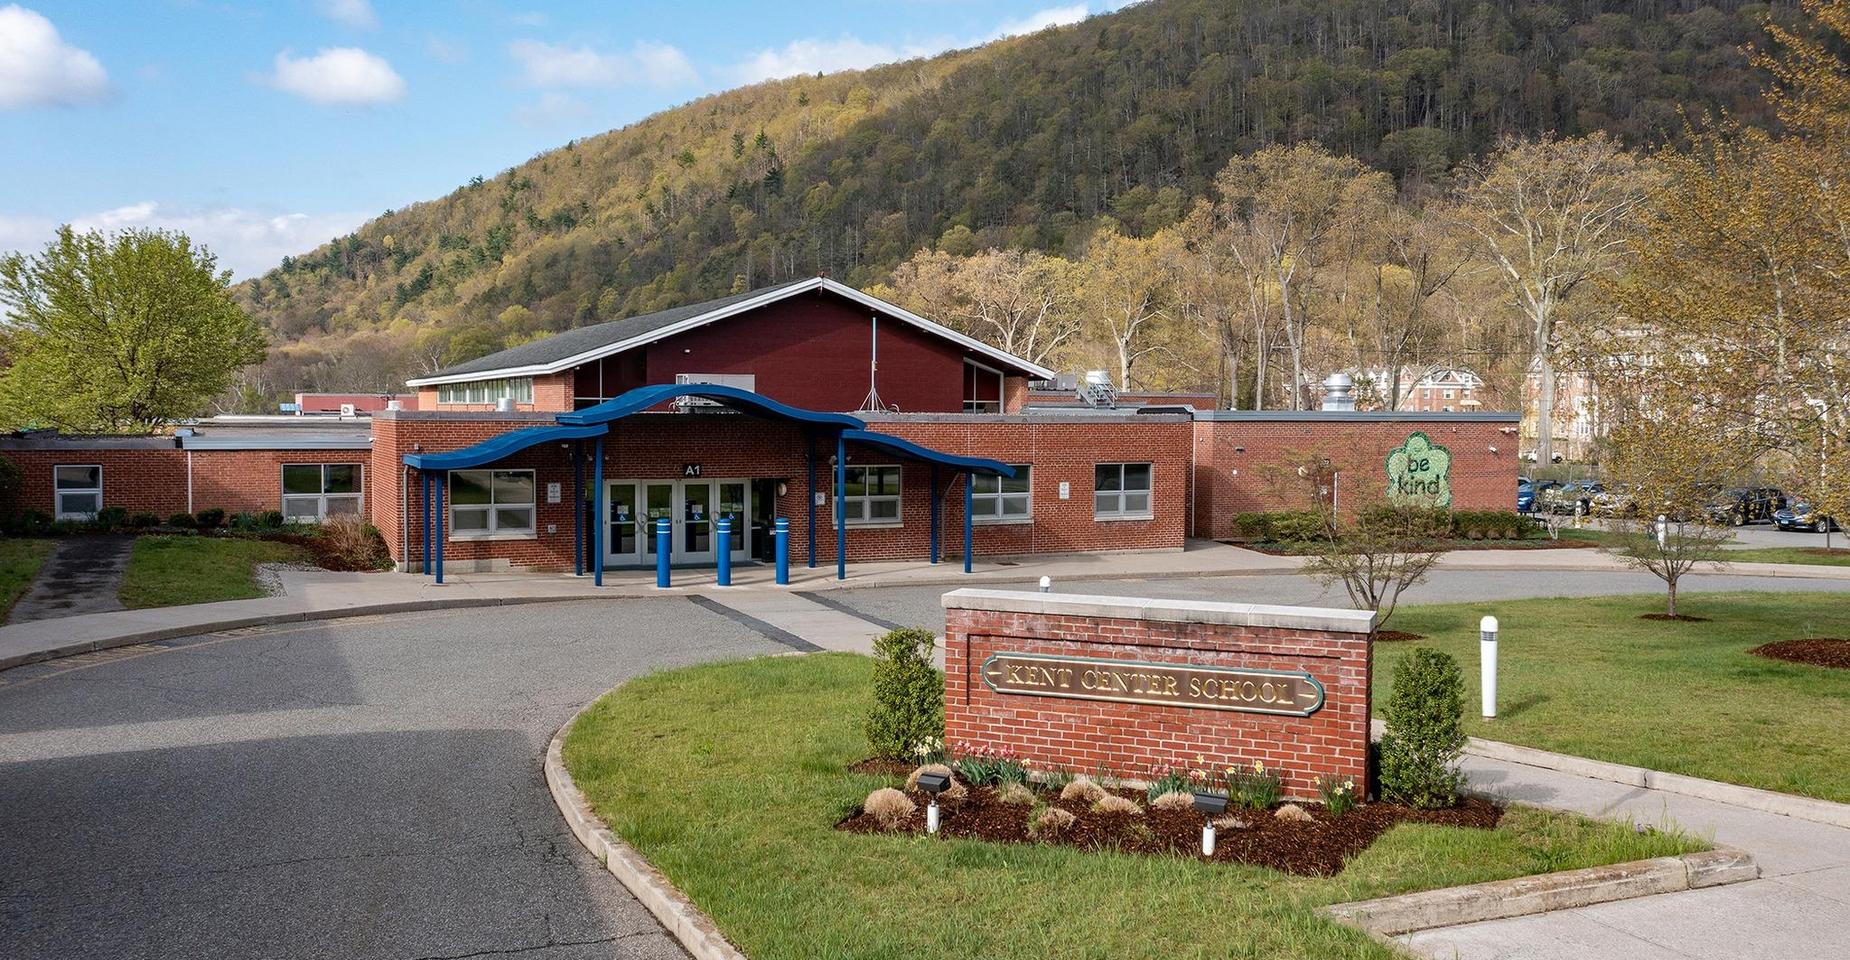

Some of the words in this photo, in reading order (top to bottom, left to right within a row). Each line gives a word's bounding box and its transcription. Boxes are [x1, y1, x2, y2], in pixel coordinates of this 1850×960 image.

[685, 465, 700, 475] A1
[1407, 454, 1430, 473] be
[1397, 472, 1440, 495] kind
[1005, 664, 1073, 688] KENT
[1081, 669, 1180, 697] CENTER
[1189, 677, 1295, 705] SCHOOL
